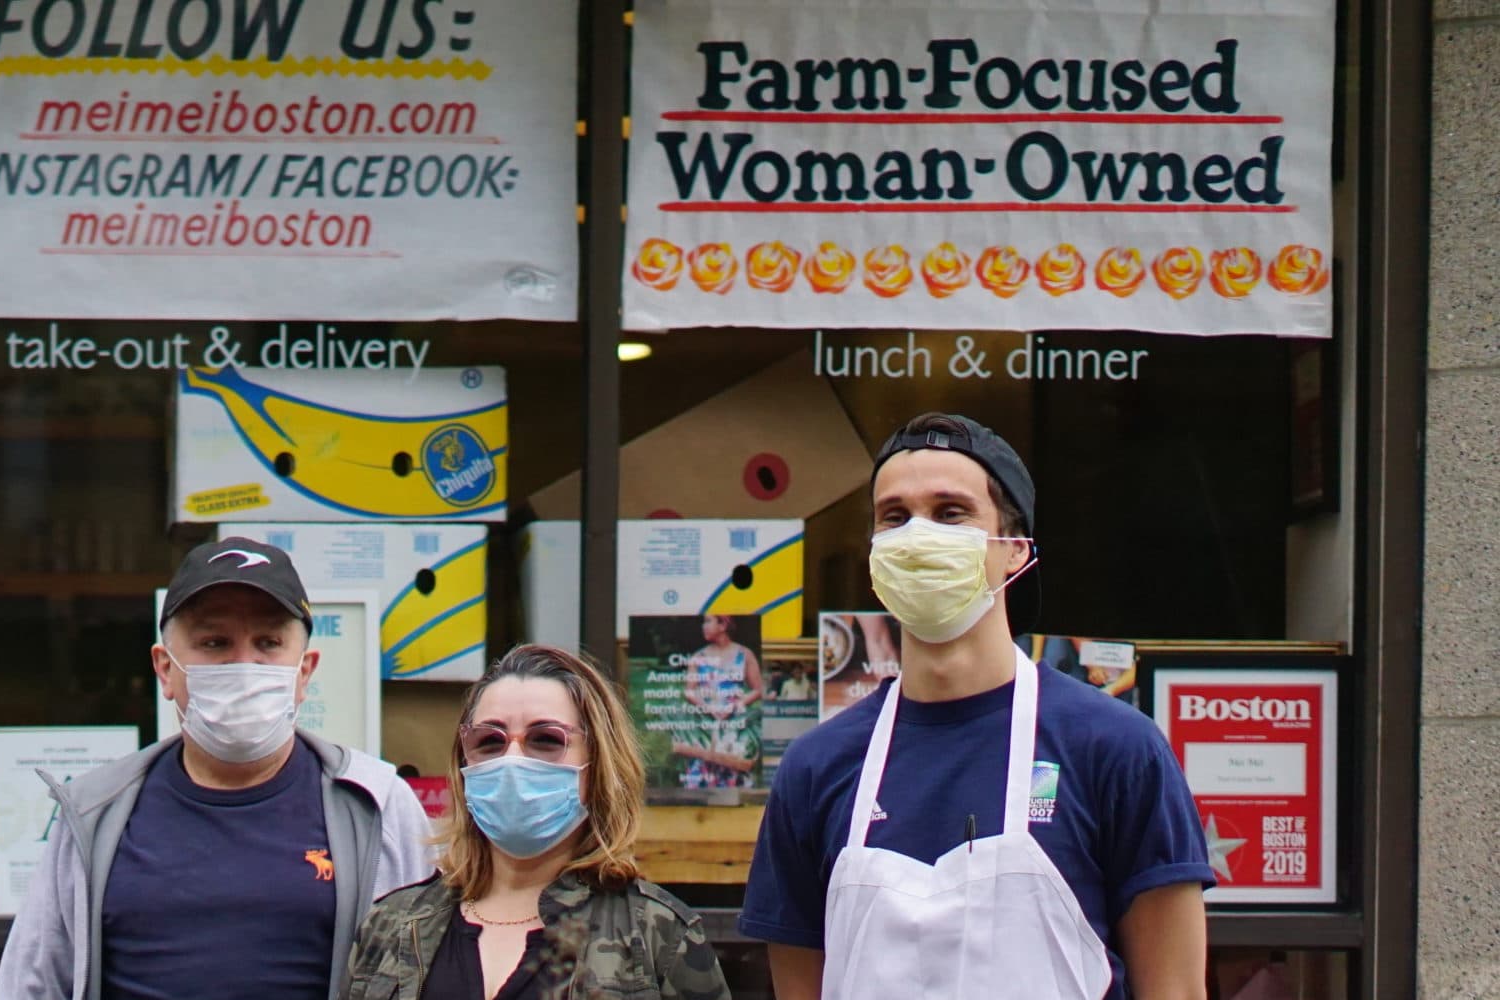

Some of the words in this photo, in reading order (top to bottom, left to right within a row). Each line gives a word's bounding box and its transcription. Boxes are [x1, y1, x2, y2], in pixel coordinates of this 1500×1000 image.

[696, 39, 1241, 115] Farm-Focused
[35, 90, 477, 137] meimeiboston.com
[655, 129, 1285, 205] Woman-Owned
[61, 203, 371, 248] meimeiboston
[6, 323, 190, 370] take-out
[205, 327, 247, 370] &
[260, 325, 431, 385] delivery
[812, 331, 931, 379] lunch
[948, 335, 992, 380] &
[1005, 332, 1149, 381] dinner
[434, 455, 495, 499] Chiquita
[1178, 694, 1312, 721] Boston
[1029, 808, 1055, 817] 007
[1262, 816, 1294, 832] BEST
[1262, 832, 1307, 848] BOSTON
[1262, 851, 1307, 875] 2019
